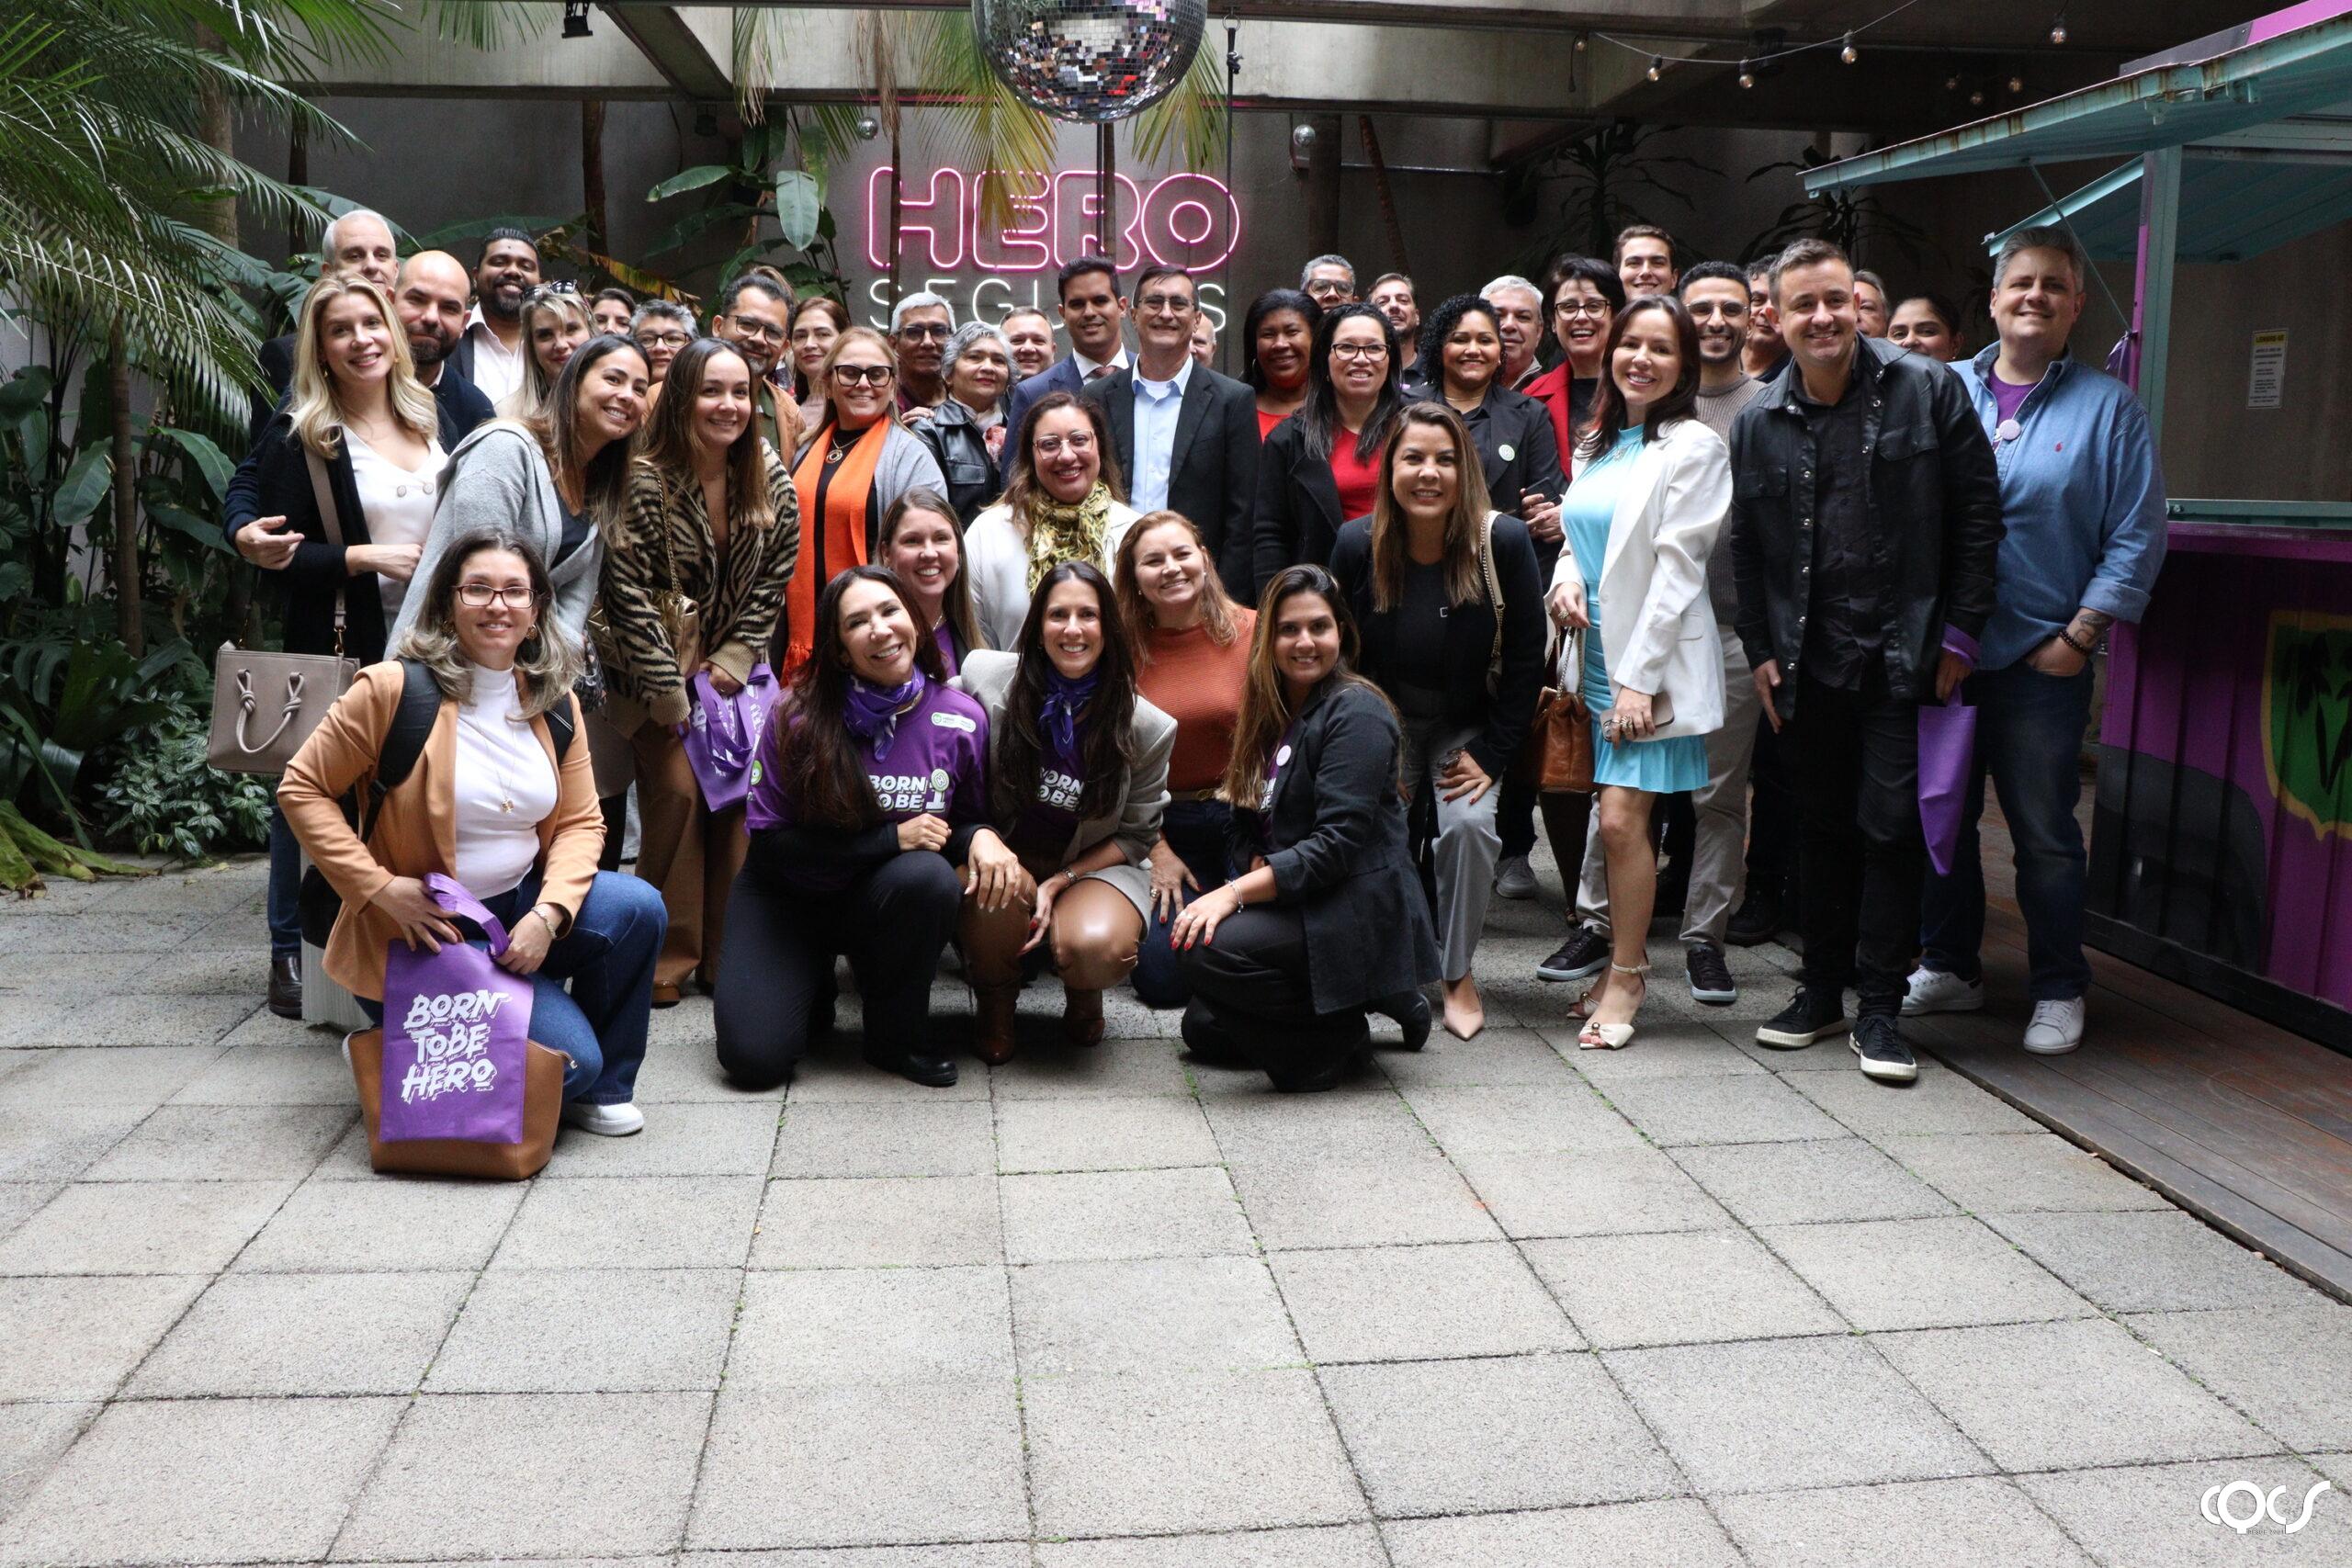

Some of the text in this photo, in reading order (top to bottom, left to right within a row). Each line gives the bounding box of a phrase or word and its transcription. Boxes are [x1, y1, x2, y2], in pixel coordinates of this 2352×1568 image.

[868, 165, 1240, 273] HERO
[868, 775, 927, 794] BORN
[1049, 789, 1080, 812] BE
[895, 795, 925, 812] BE
[403, 989, 513, 1030] BORN
[401, 1058, 498, 1104] HERO
